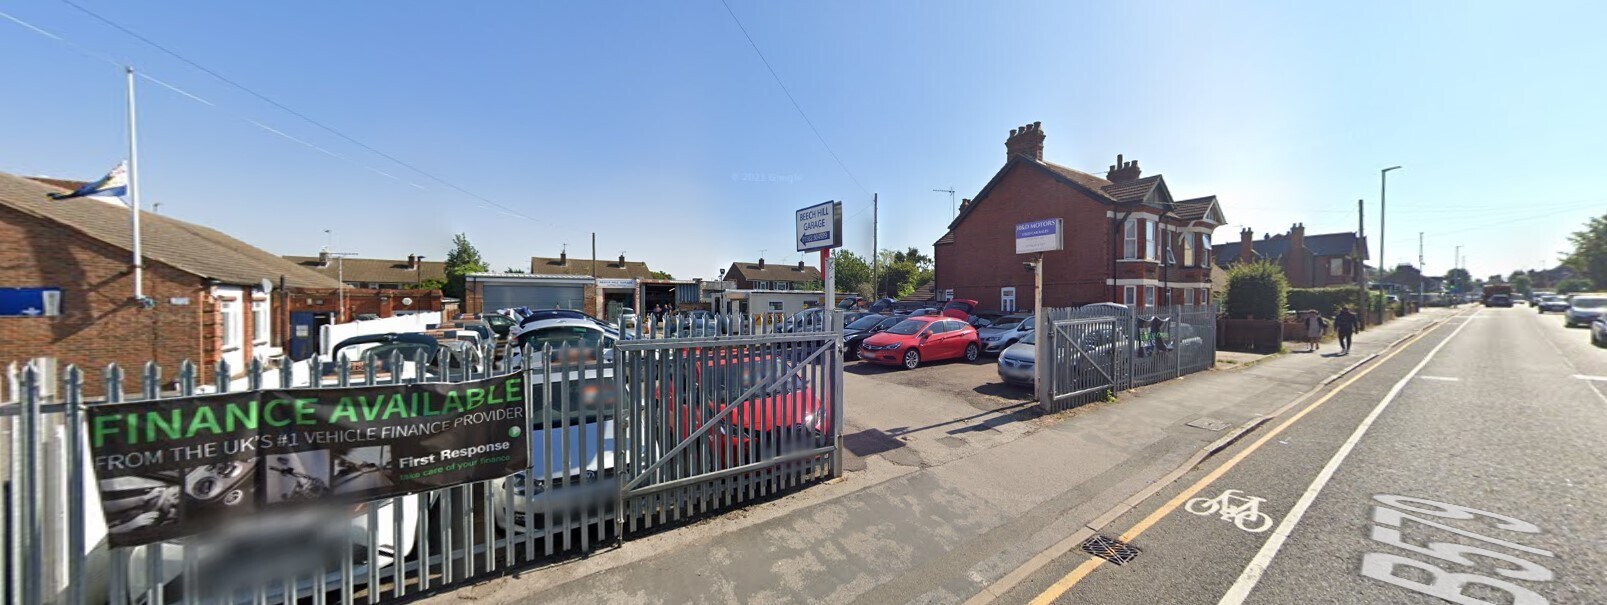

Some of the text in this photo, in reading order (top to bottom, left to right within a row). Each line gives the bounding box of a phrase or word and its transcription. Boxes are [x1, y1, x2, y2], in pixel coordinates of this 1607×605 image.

[800, 207, 829, 221] BEECH HILL
[804, 218, 825, 231] GARAGE
[1030, 220, 1056, 228] MOTORS
[93, 378, 523, 448] FINANCE AVAILABLE
[94, 406, 524, 471] FROM THE UK'S #1 VEHICLE FINANCE PROVIDER
[398, 440, 511, 469] First Response
[400, 454, 512, 481] take care of your finance
[1361, 494, 1555, 605] B579
